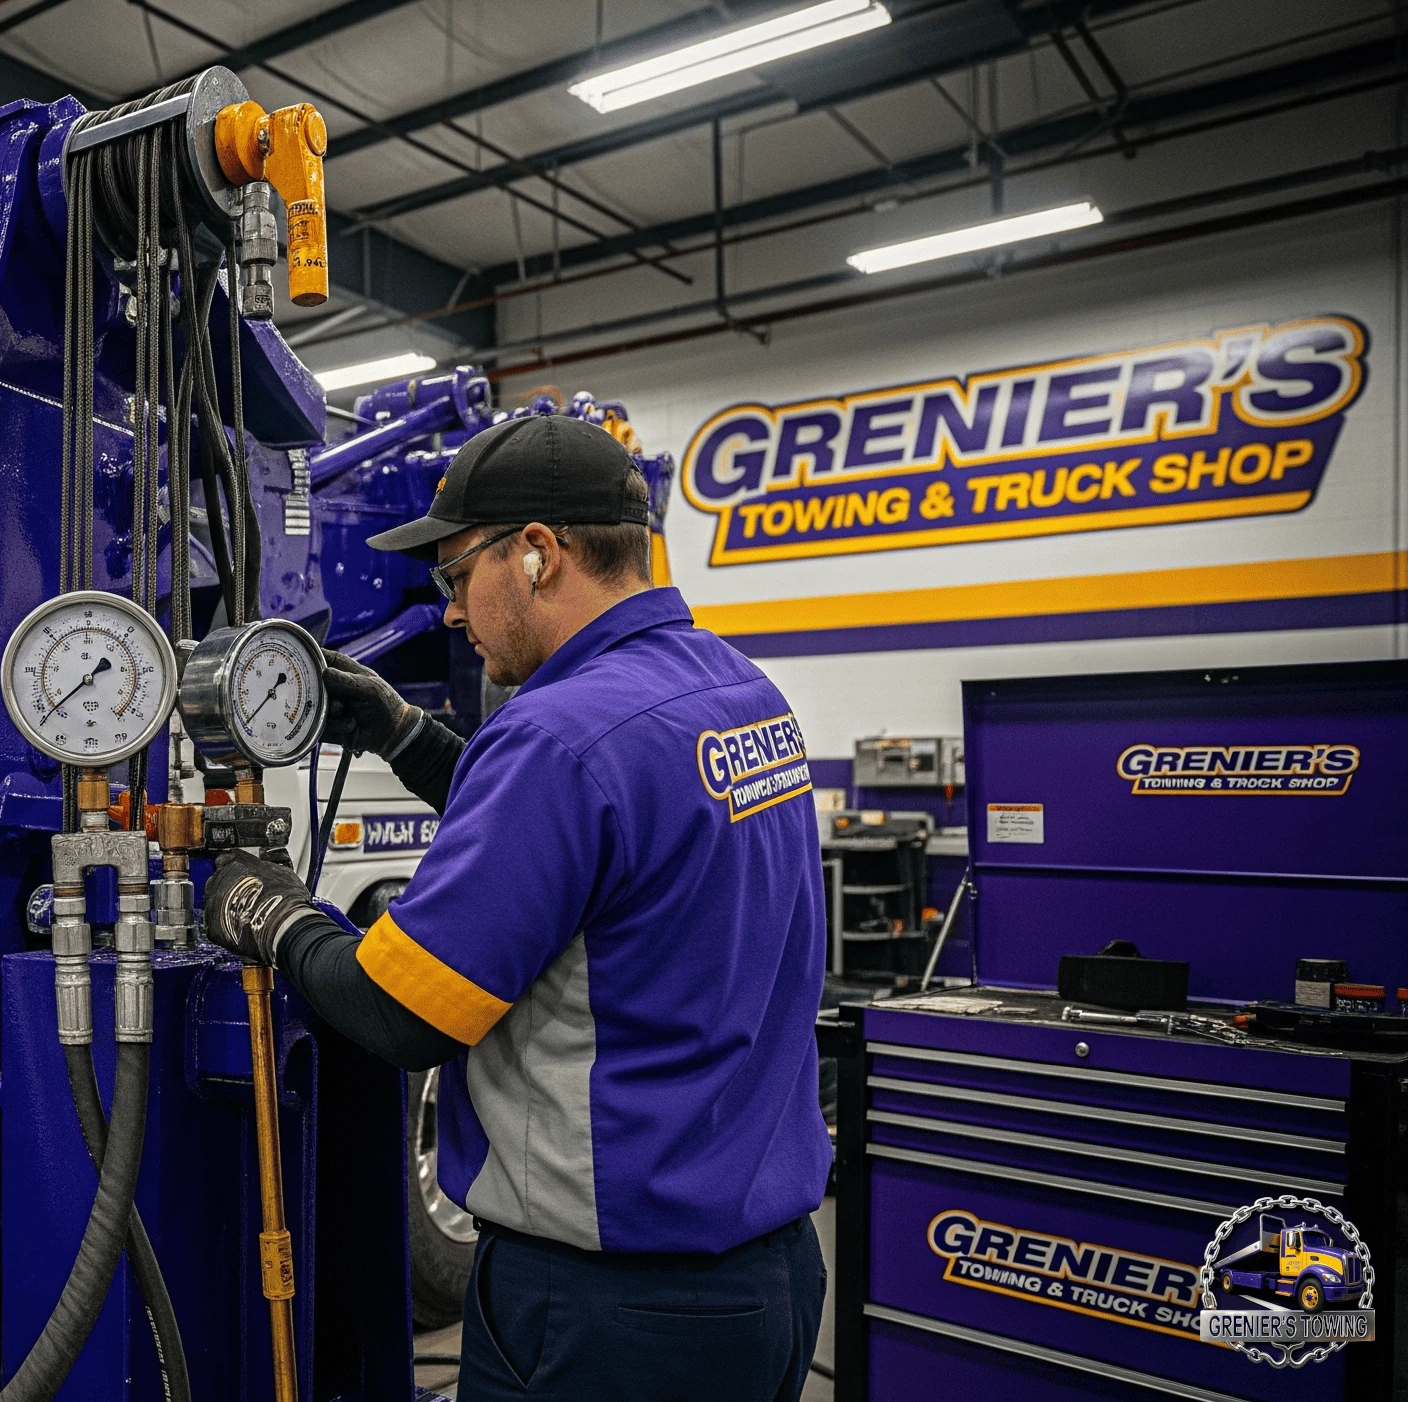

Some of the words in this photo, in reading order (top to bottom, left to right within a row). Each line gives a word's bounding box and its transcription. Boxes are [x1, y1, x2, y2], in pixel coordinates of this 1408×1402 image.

[691, 325, 1349, 502] GRENIER'S
[738, 486, 911, 539] TOWING
[919, 481, 955, 520] &
[966, 457, 1142, 514] TRUCK
[1148, 438, 1315, 494] SHOP
[1120, 746, 1359, 777] GRENIER'S
[932, 1214, 1199, 1304] GRENIER
[1047, 1282, 1063, 1298] &
[1070, 1285, 1150, 1318] TRUCK
[1154, 1306, 1200, 1331] SHO
